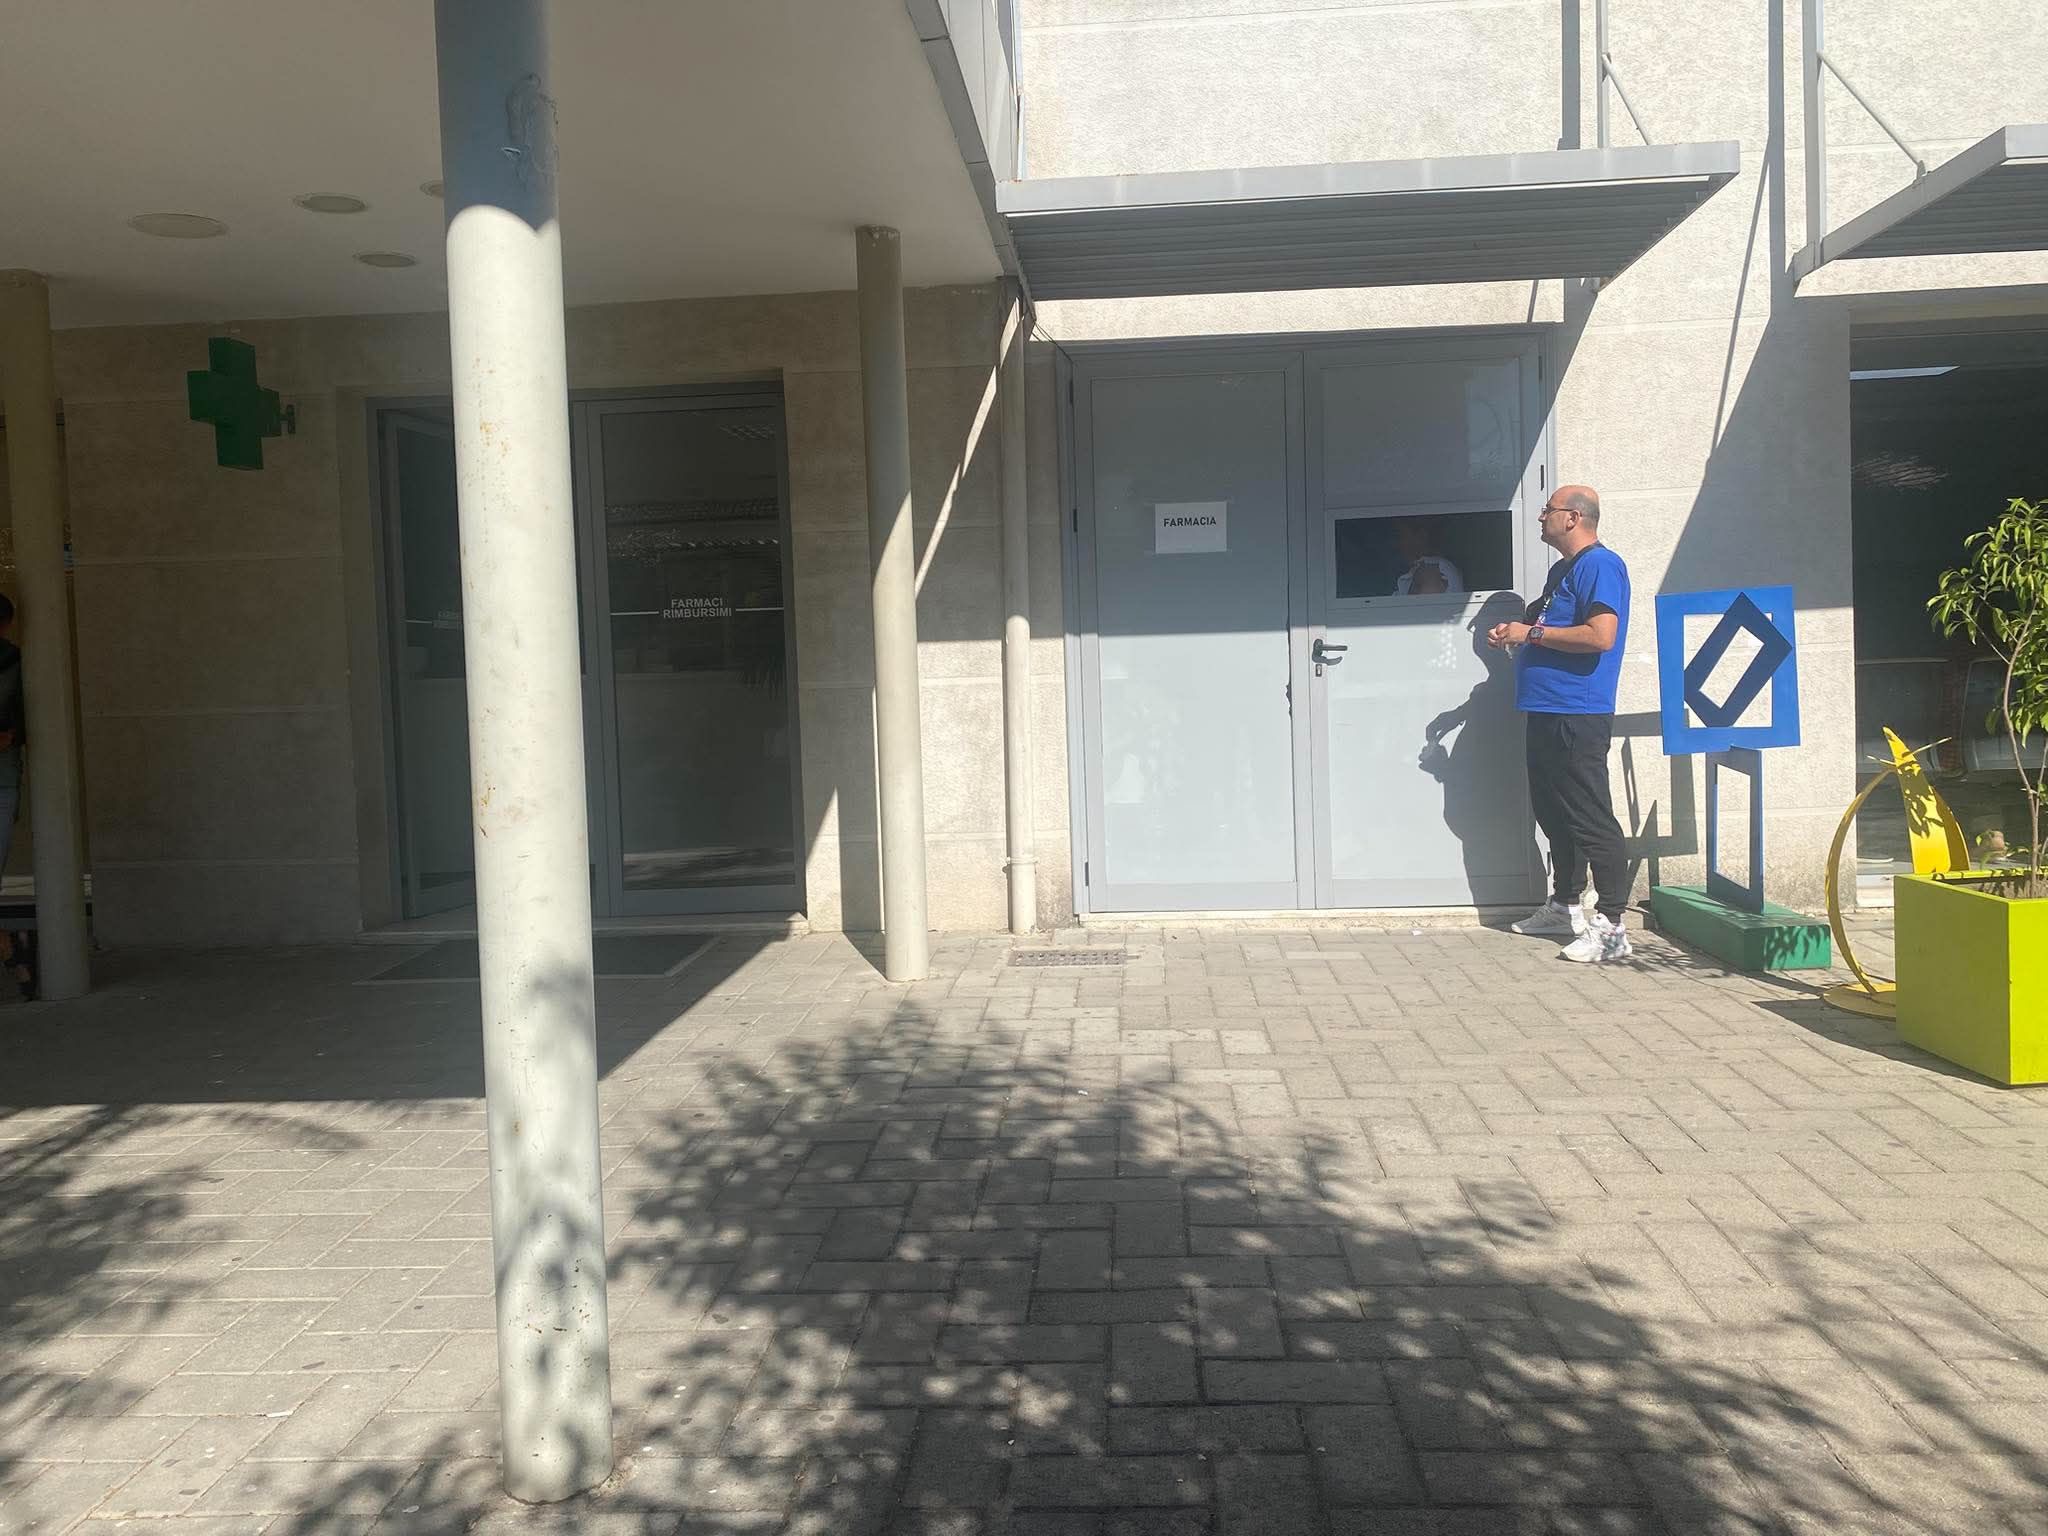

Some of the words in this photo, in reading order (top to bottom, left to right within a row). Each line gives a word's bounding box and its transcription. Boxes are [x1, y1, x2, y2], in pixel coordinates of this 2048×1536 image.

[1163, 516, 1217, 527] FARMACIA
[671, 597, 723, 608] FARMACI
[663, 607, 732, 618] RIMBURSIMI
